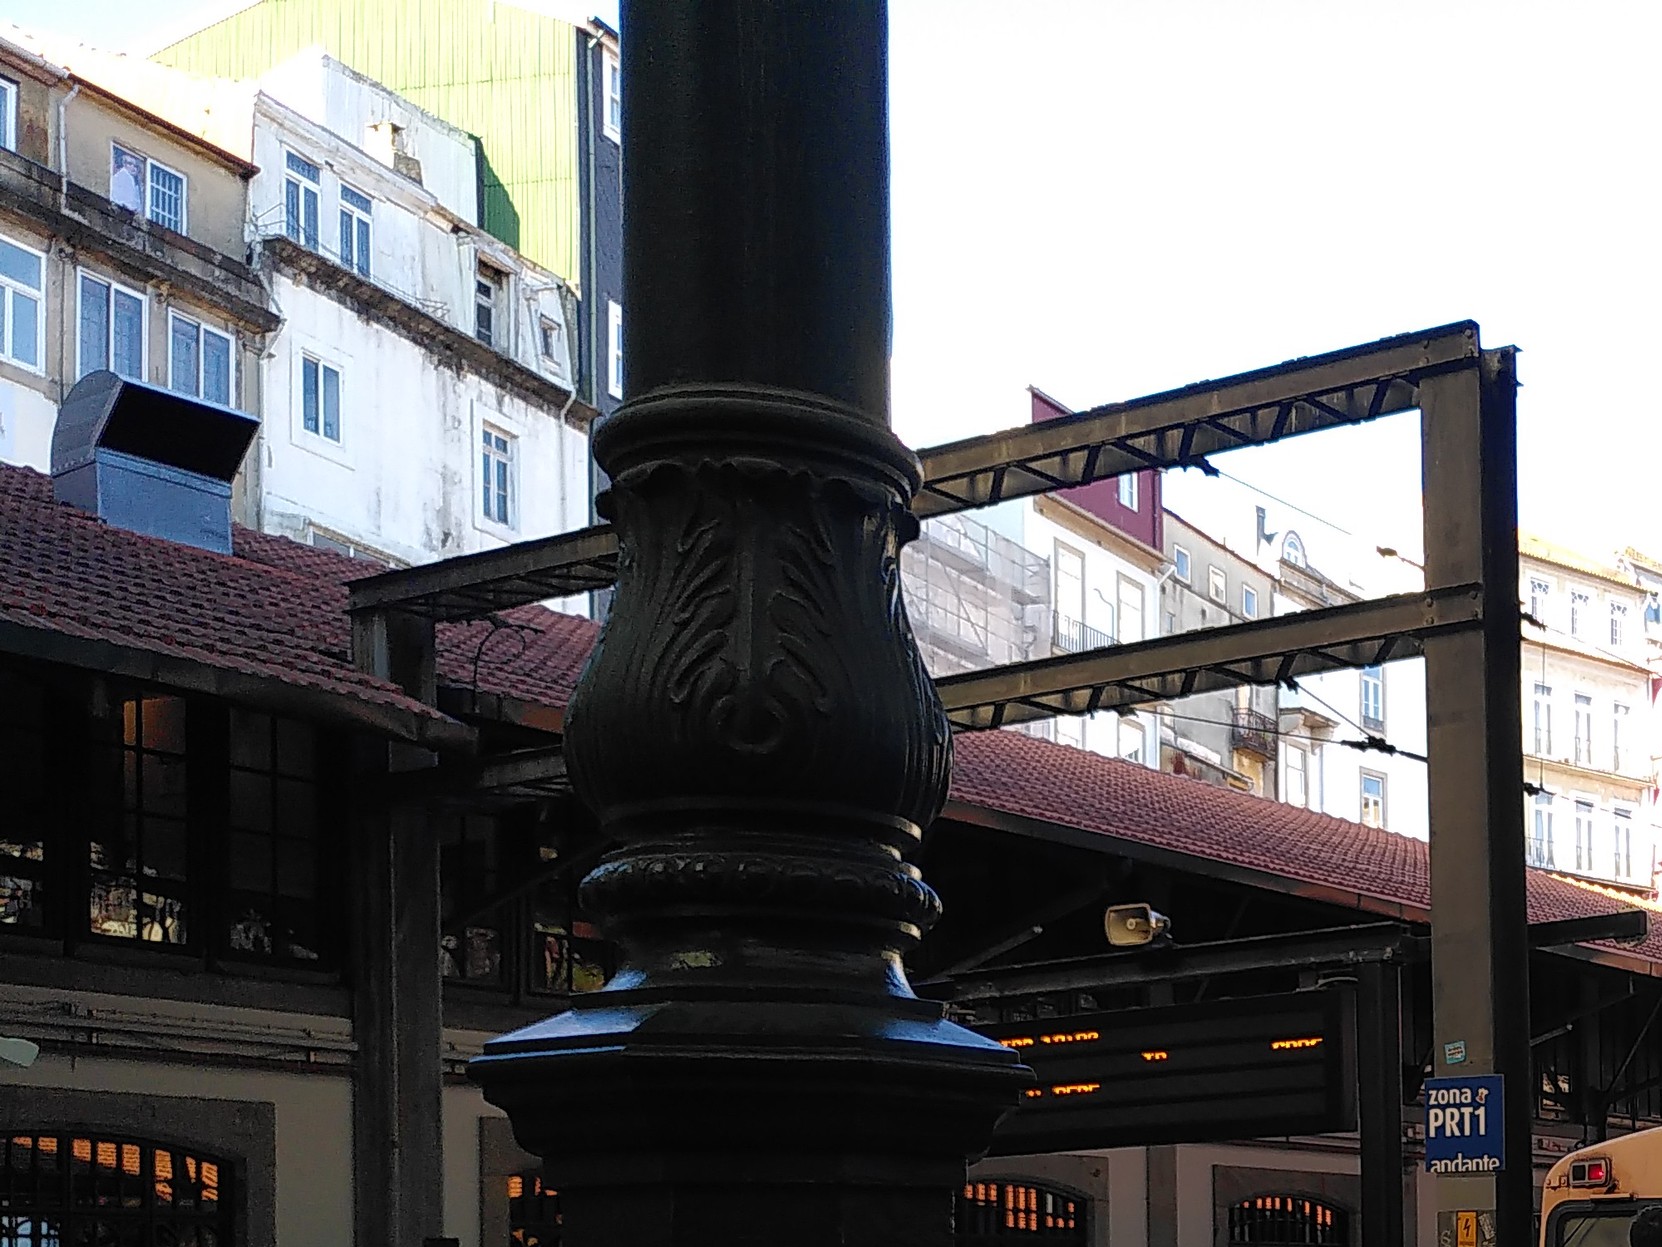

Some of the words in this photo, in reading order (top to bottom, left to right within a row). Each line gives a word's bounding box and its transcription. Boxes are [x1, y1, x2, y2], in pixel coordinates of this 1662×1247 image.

[1428, 1088, 1472, 1106] zona
[1428, 1106, 1487, 1138] PRT1
[1430, 1153, 1500, 1173] andante
